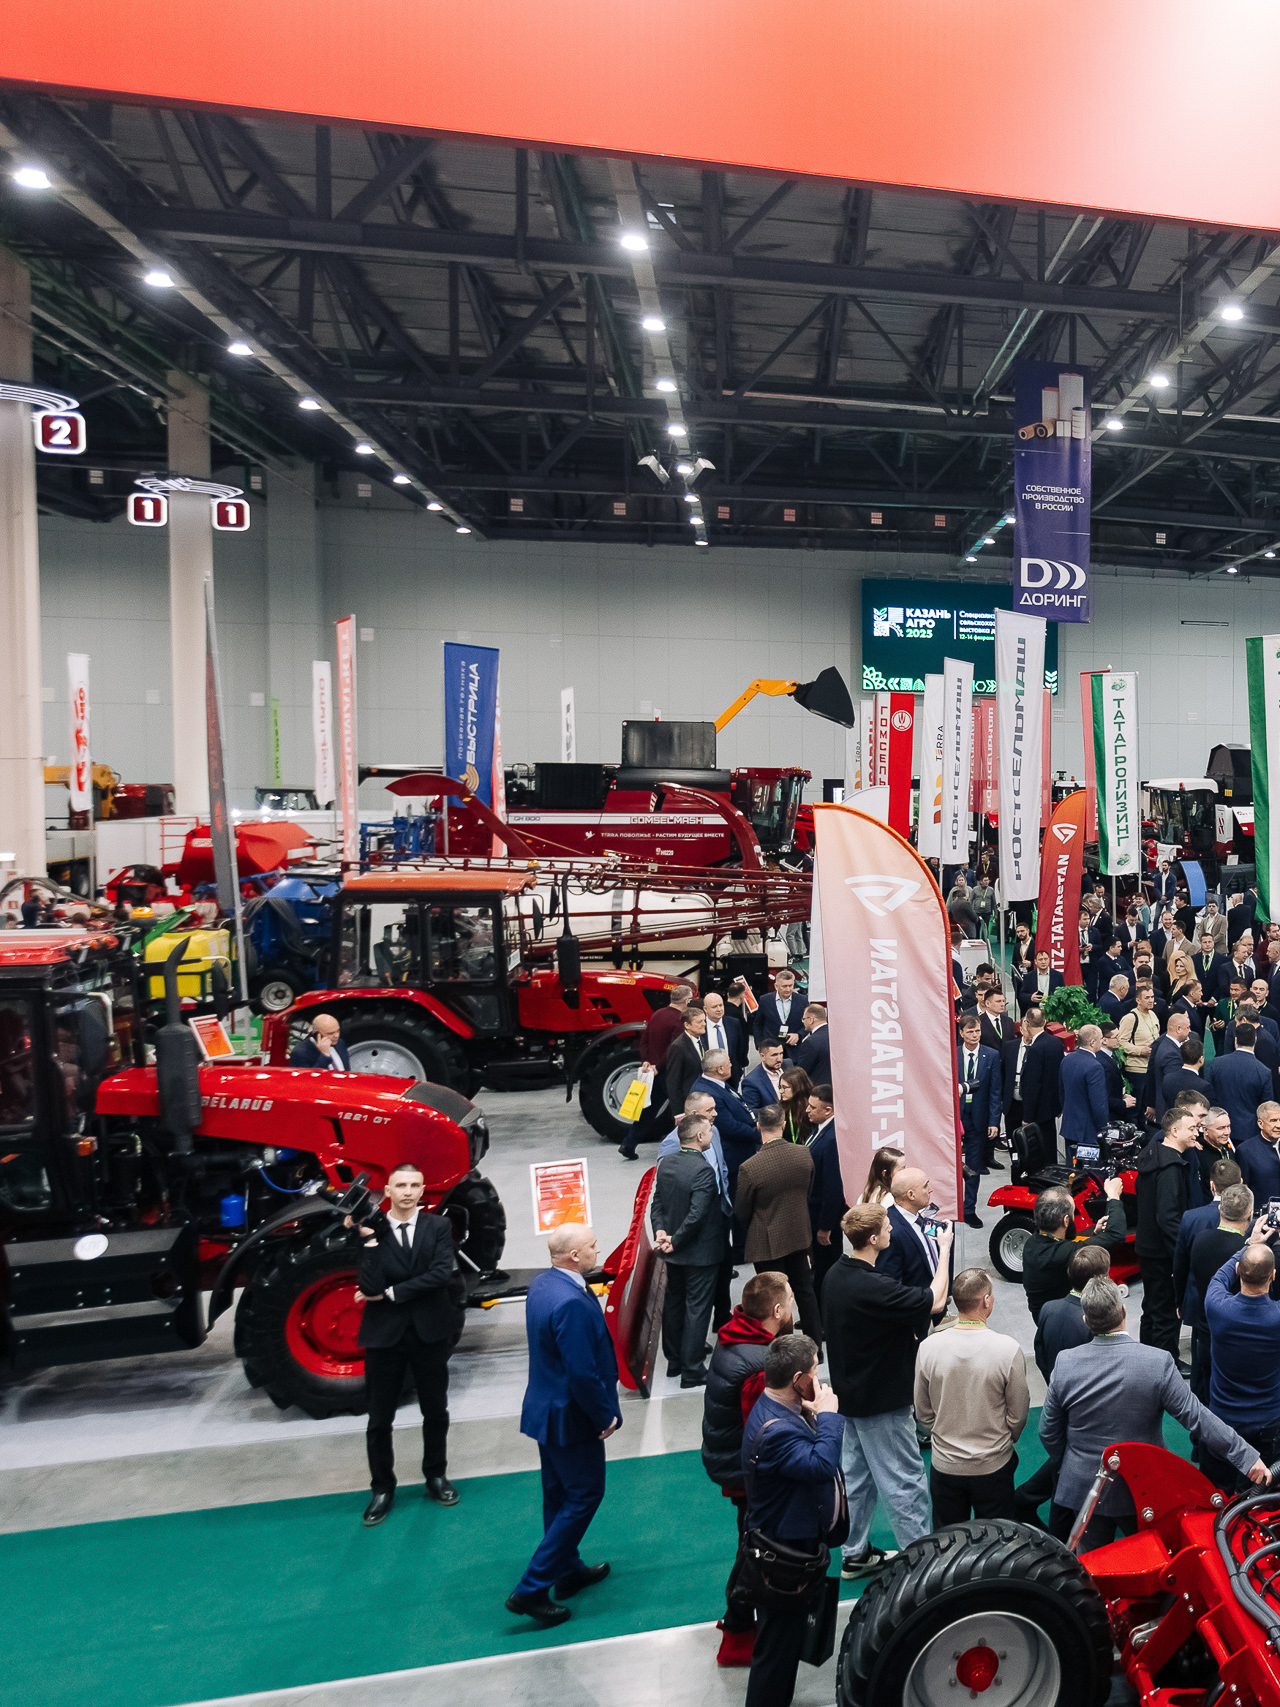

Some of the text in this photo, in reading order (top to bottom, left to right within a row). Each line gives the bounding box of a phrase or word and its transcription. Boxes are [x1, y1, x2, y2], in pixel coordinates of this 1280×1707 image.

[49, 419, 72, 445] 2
[1026, 484, 1081, 495] СОБСТВЕННОЕ
[1022, 493, 1085, 504] ПРОИЗВОДСТВО
[141, 499, 154, 520] 1
[225, 504, 237, 525] 1
[1045, 503, 1074, 512] РОССИИ
[1019, 592, 1086, 608] ДОРИНГ
[906, 608, 951, 619] КАЗАНЬ
[906, 619, 935, 628] АГРО
[906, 628, 933, 638] 2025
[466, 663, 480, 765] БЫСТРИЦА
[1113, 698, 1129, 847] ТАТАГРОЛИЗИНГ
[630, 816, 704, 825] GOMSELMASH
[1051, 855, 1069, 972] TZ-TATARSTAN
[202, 1096, 273, 1112] BELARUS
[338, 1112, 391, 1125] 1221 GT
